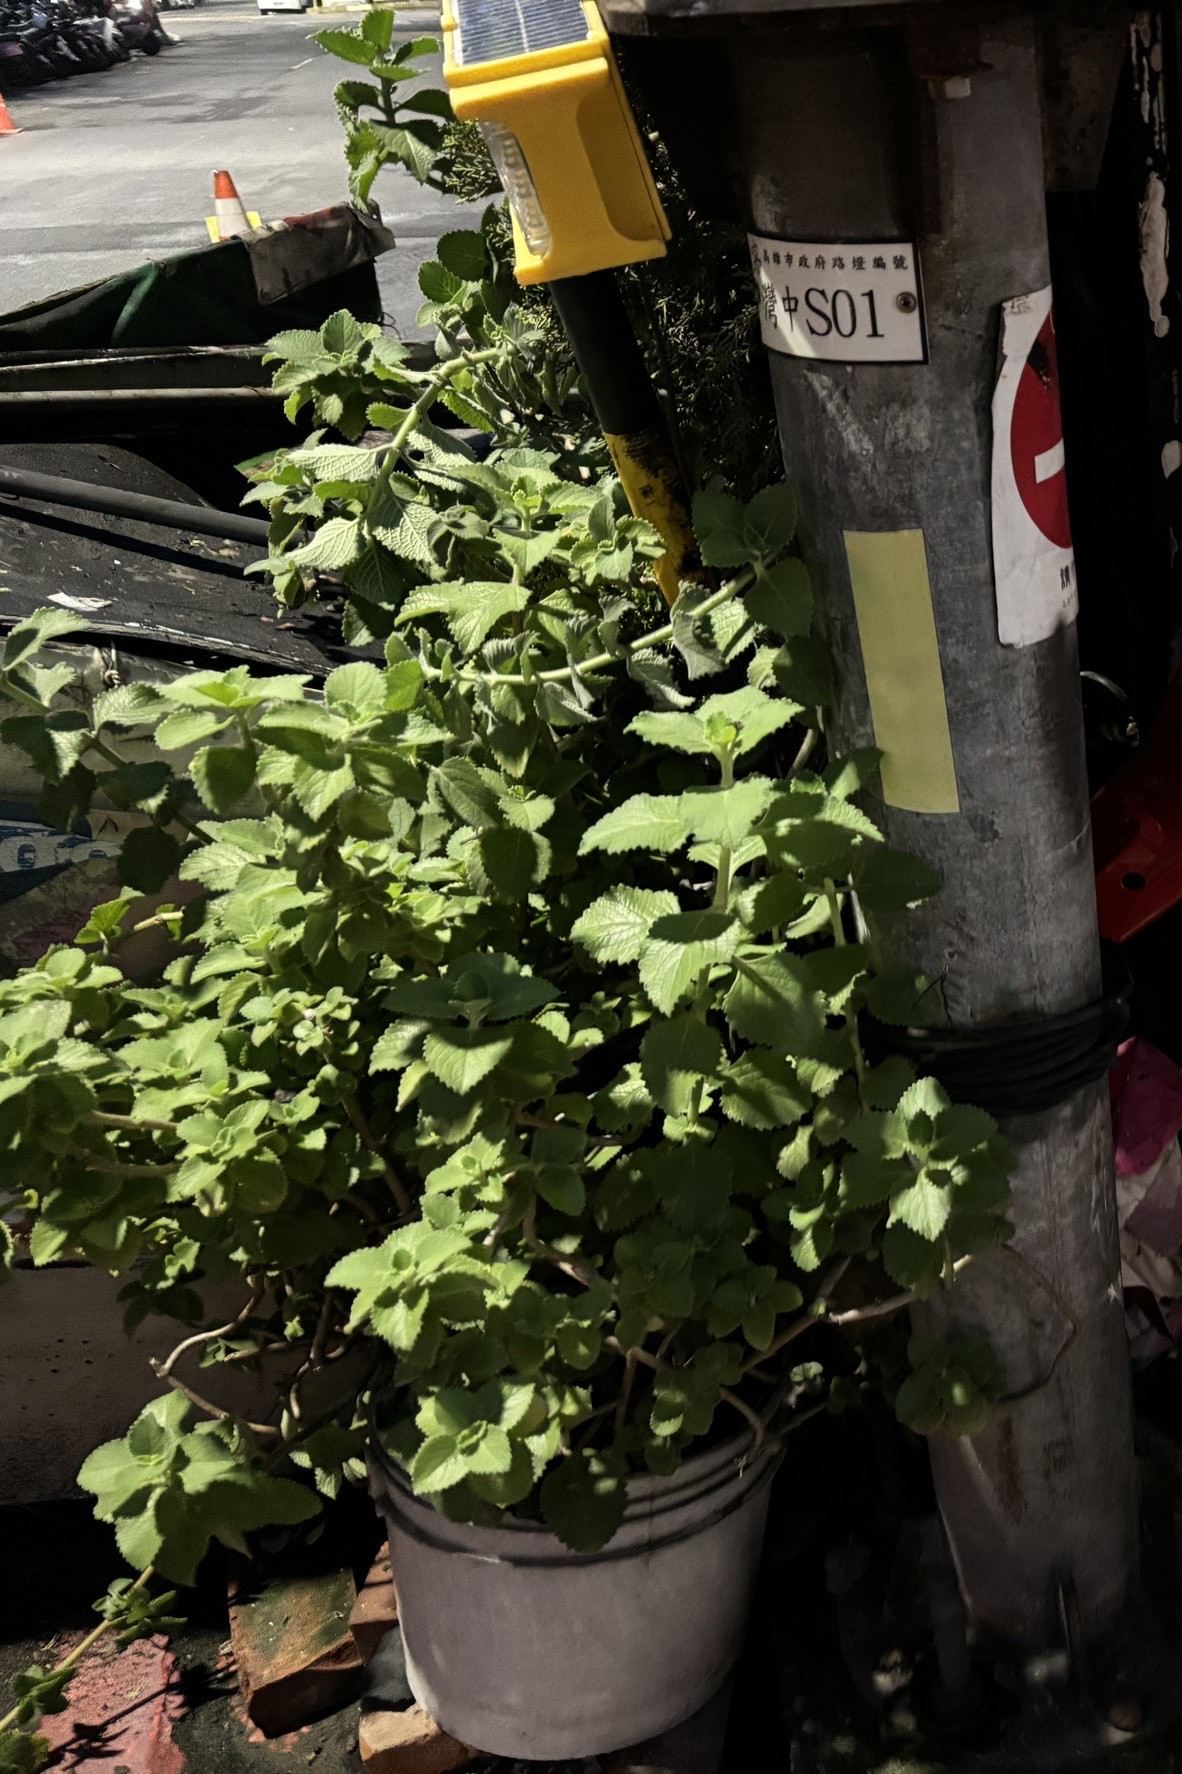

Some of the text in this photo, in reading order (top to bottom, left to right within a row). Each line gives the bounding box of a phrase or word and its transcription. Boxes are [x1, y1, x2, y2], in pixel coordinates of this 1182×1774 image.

[763, 248, 909, 270] 高雄市政府路燈編號
